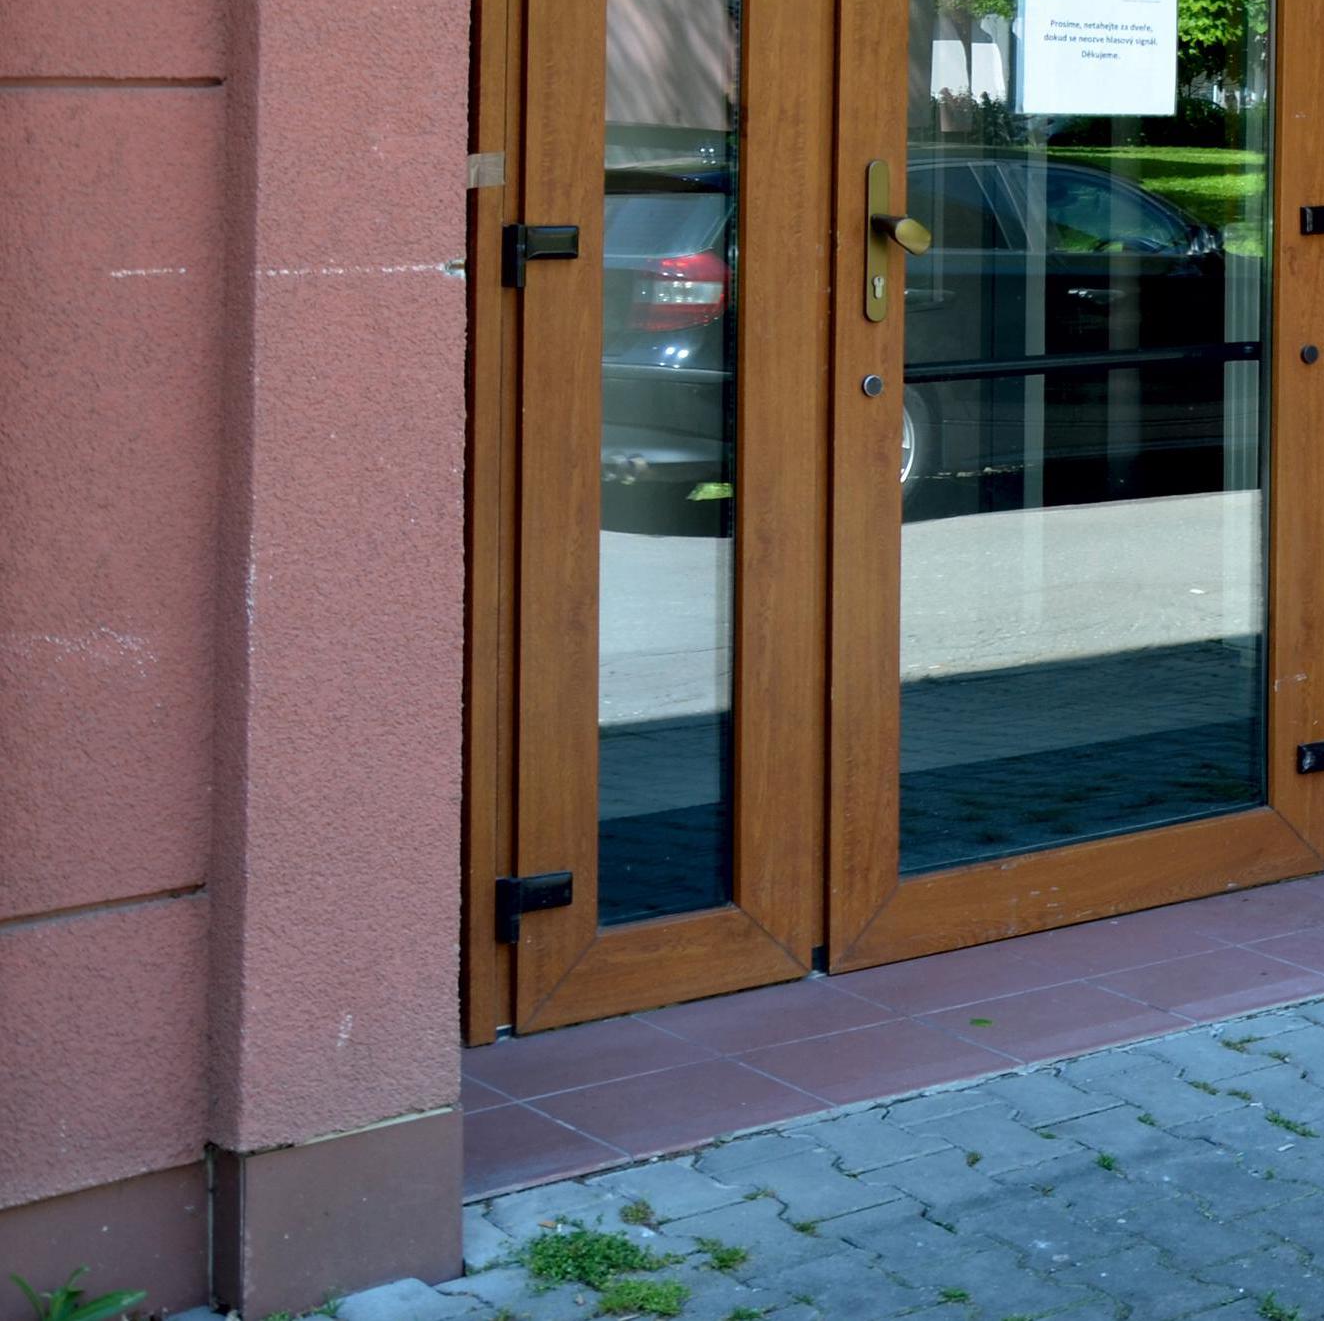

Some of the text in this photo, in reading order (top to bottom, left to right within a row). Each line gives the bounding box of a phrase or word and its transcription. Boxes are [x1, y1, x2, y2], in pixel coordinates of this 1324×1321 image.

[1083, 21, 1118, 31] netahejte
[1043, 33, 1067, 42] dokud
[1106, 35, 1133, 45] hlasový
[1081, 50, 1121, 60] Děkujeme.
